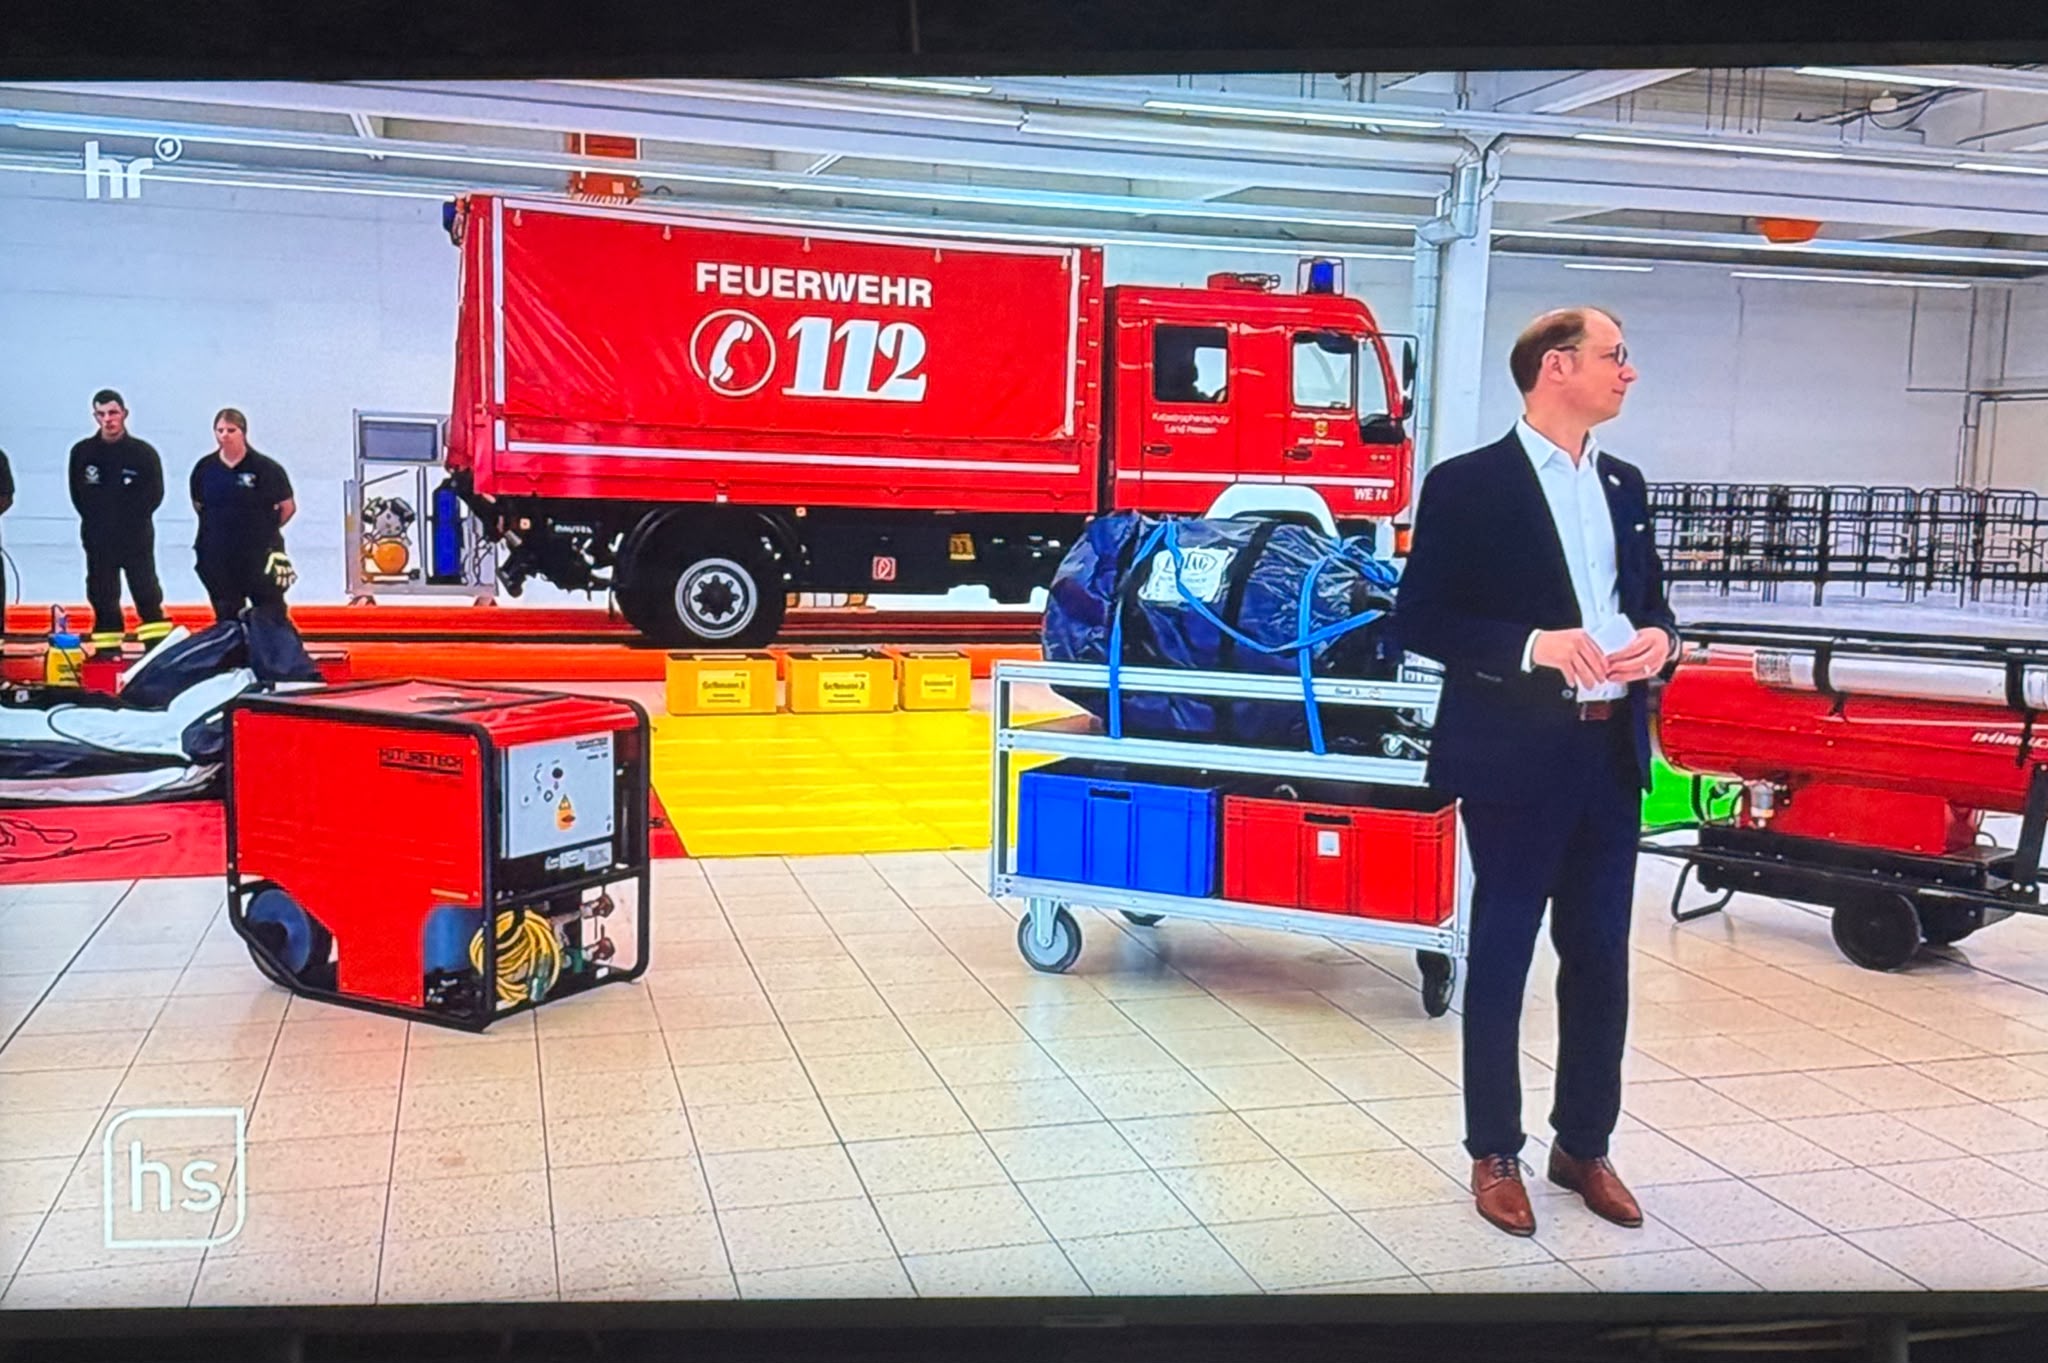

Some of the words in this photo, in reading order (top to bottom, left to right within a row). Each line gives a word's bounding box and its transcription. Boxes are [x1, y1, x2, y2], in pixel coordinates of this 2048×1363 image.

[84, 140, 154, 200] hr
[695, 261, 934, 309] FEUERWEHR
[780, 315, 928, 403] 112
[1353, 487, 1374, 501] WE
[130, 1140, 222, 1213] hs
